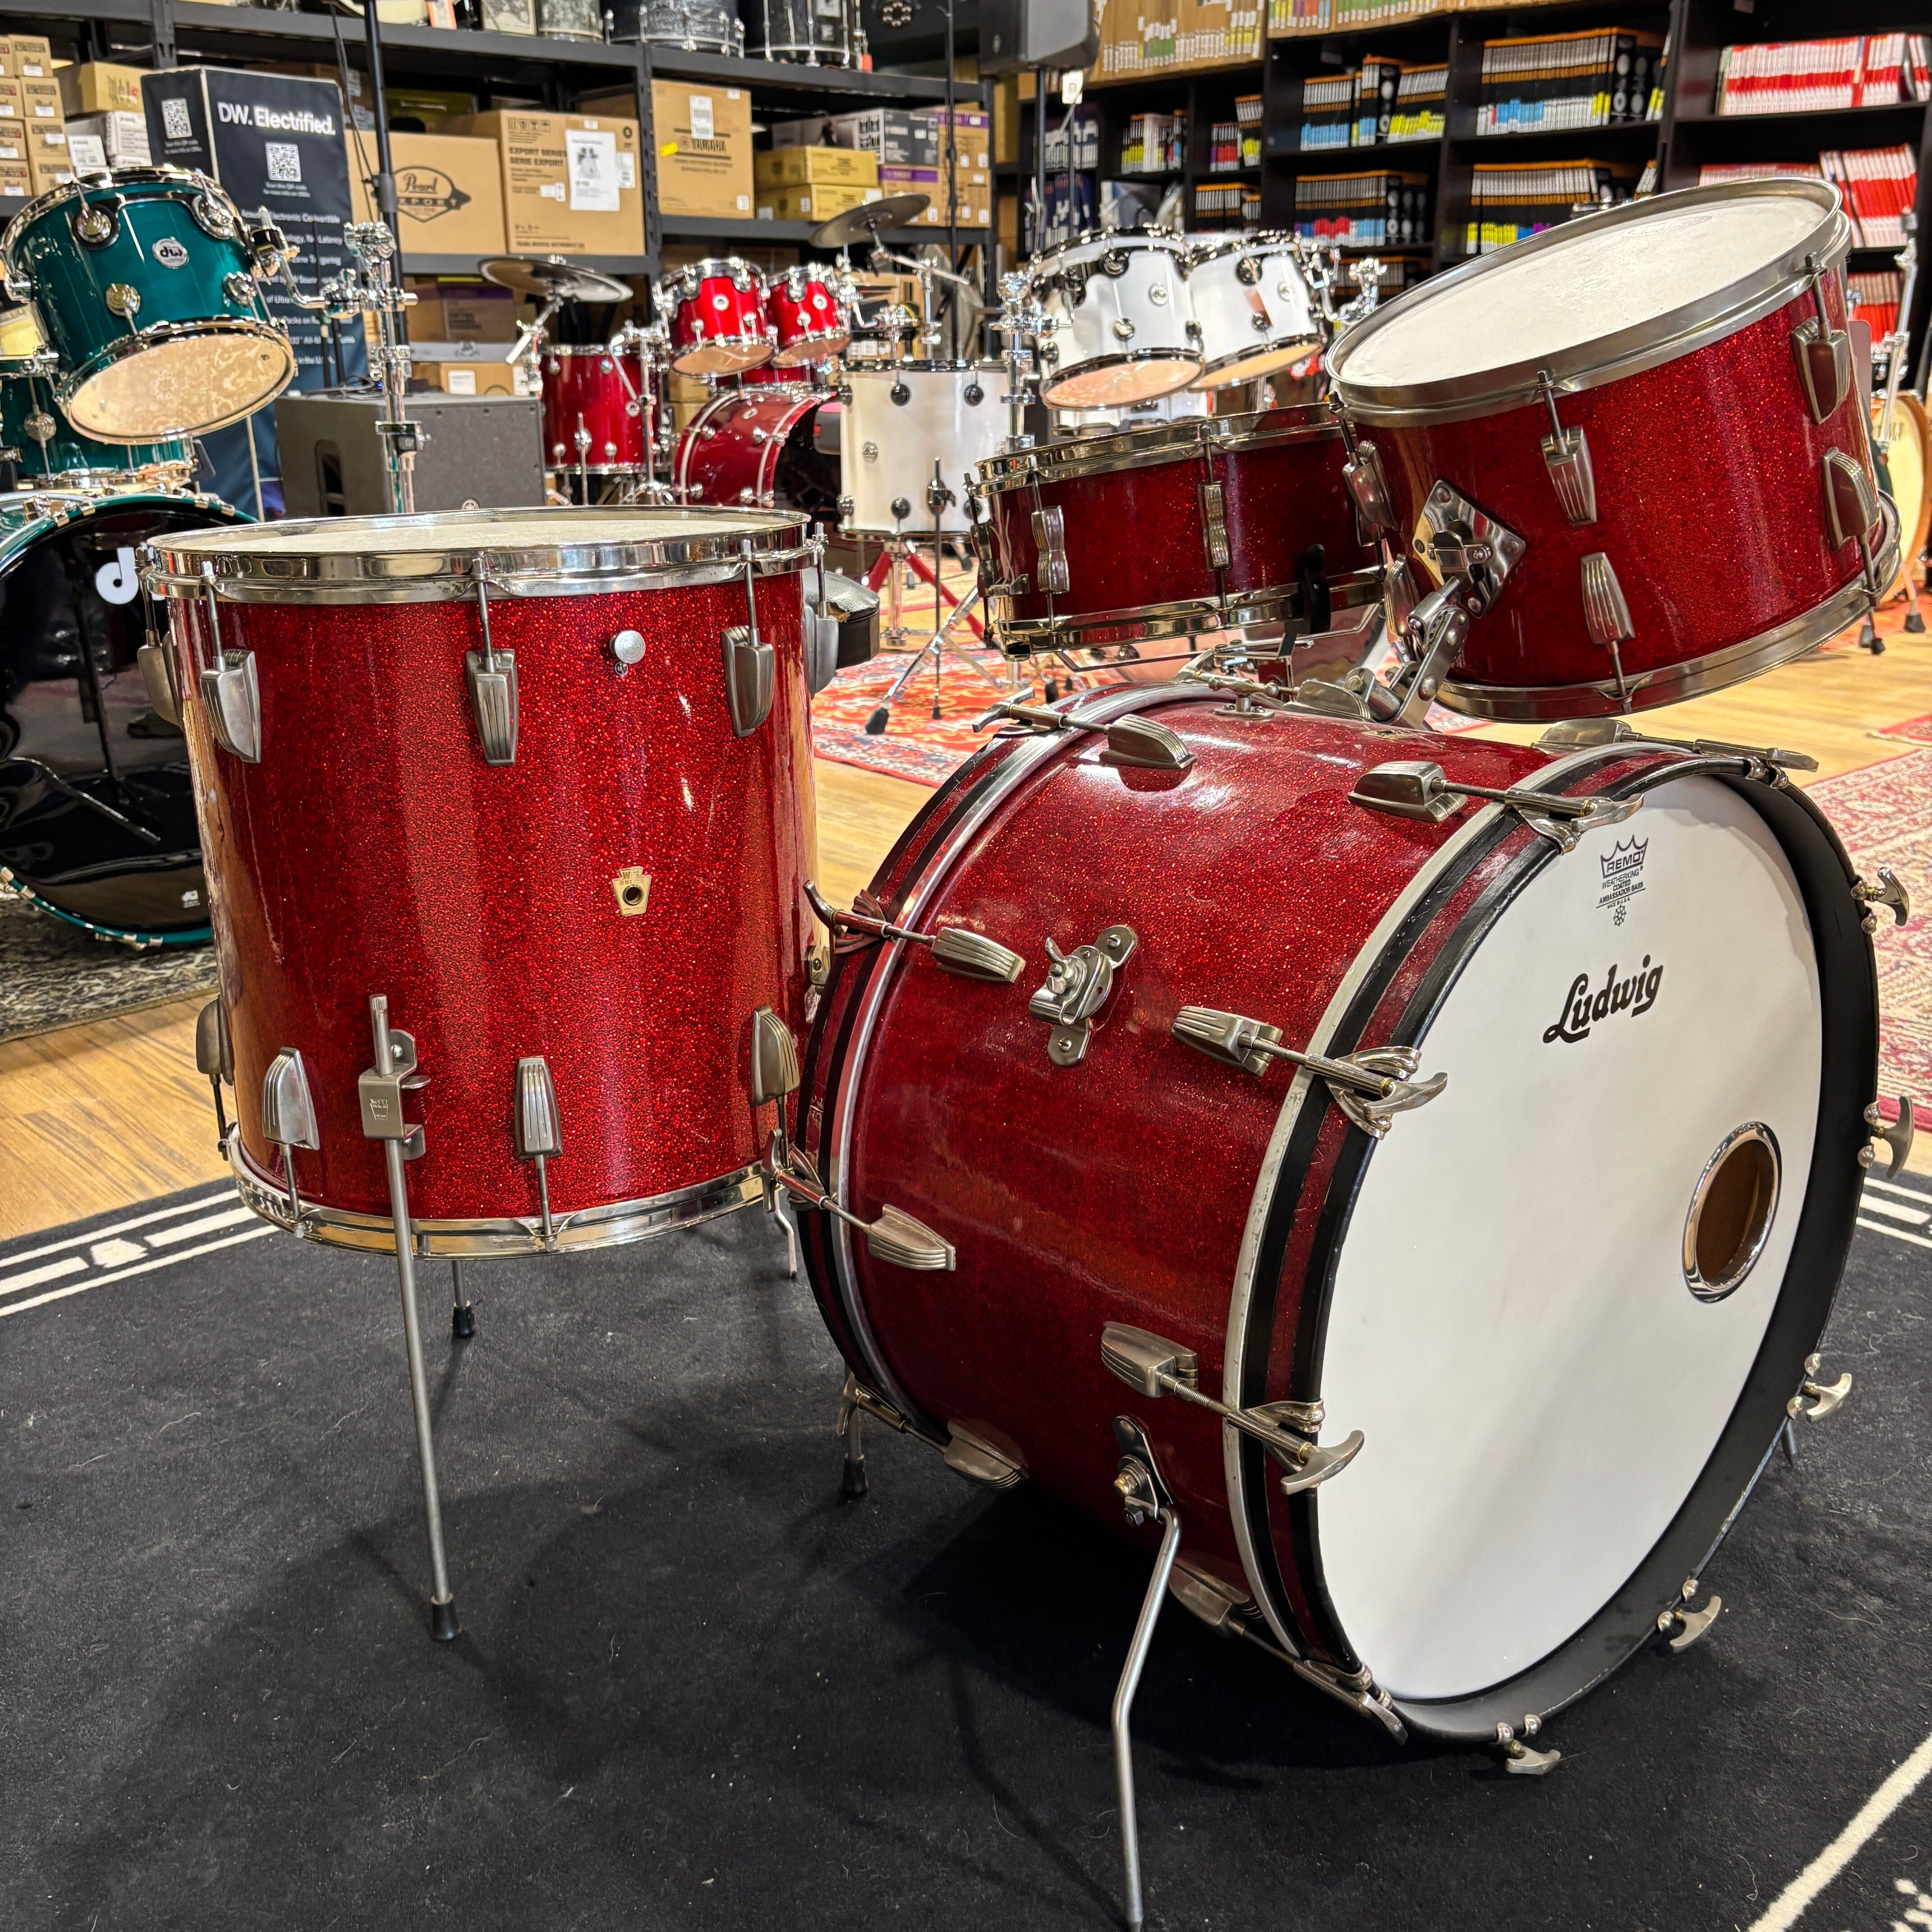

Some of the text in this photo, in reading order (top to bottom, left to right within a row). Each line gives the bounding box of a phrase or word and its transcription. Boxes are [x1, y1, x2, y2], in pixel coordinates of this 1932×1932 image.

[217, 101, 336, 135] DW. Electrified.
[509, 147, 539, 156] EXPORT
[400, 173, 438, 194] Pearl
[397, 196, 458, 207] XPORT
[160, 246, 183, 258] dw
[1606, 849, 1644, 874] REMO
[1599, 881, 1643, 904] AMBASSADOR BASS
[1613, 879, 1631, 892] COATED
[1542, 954, 1664, 1044] Ludwig
